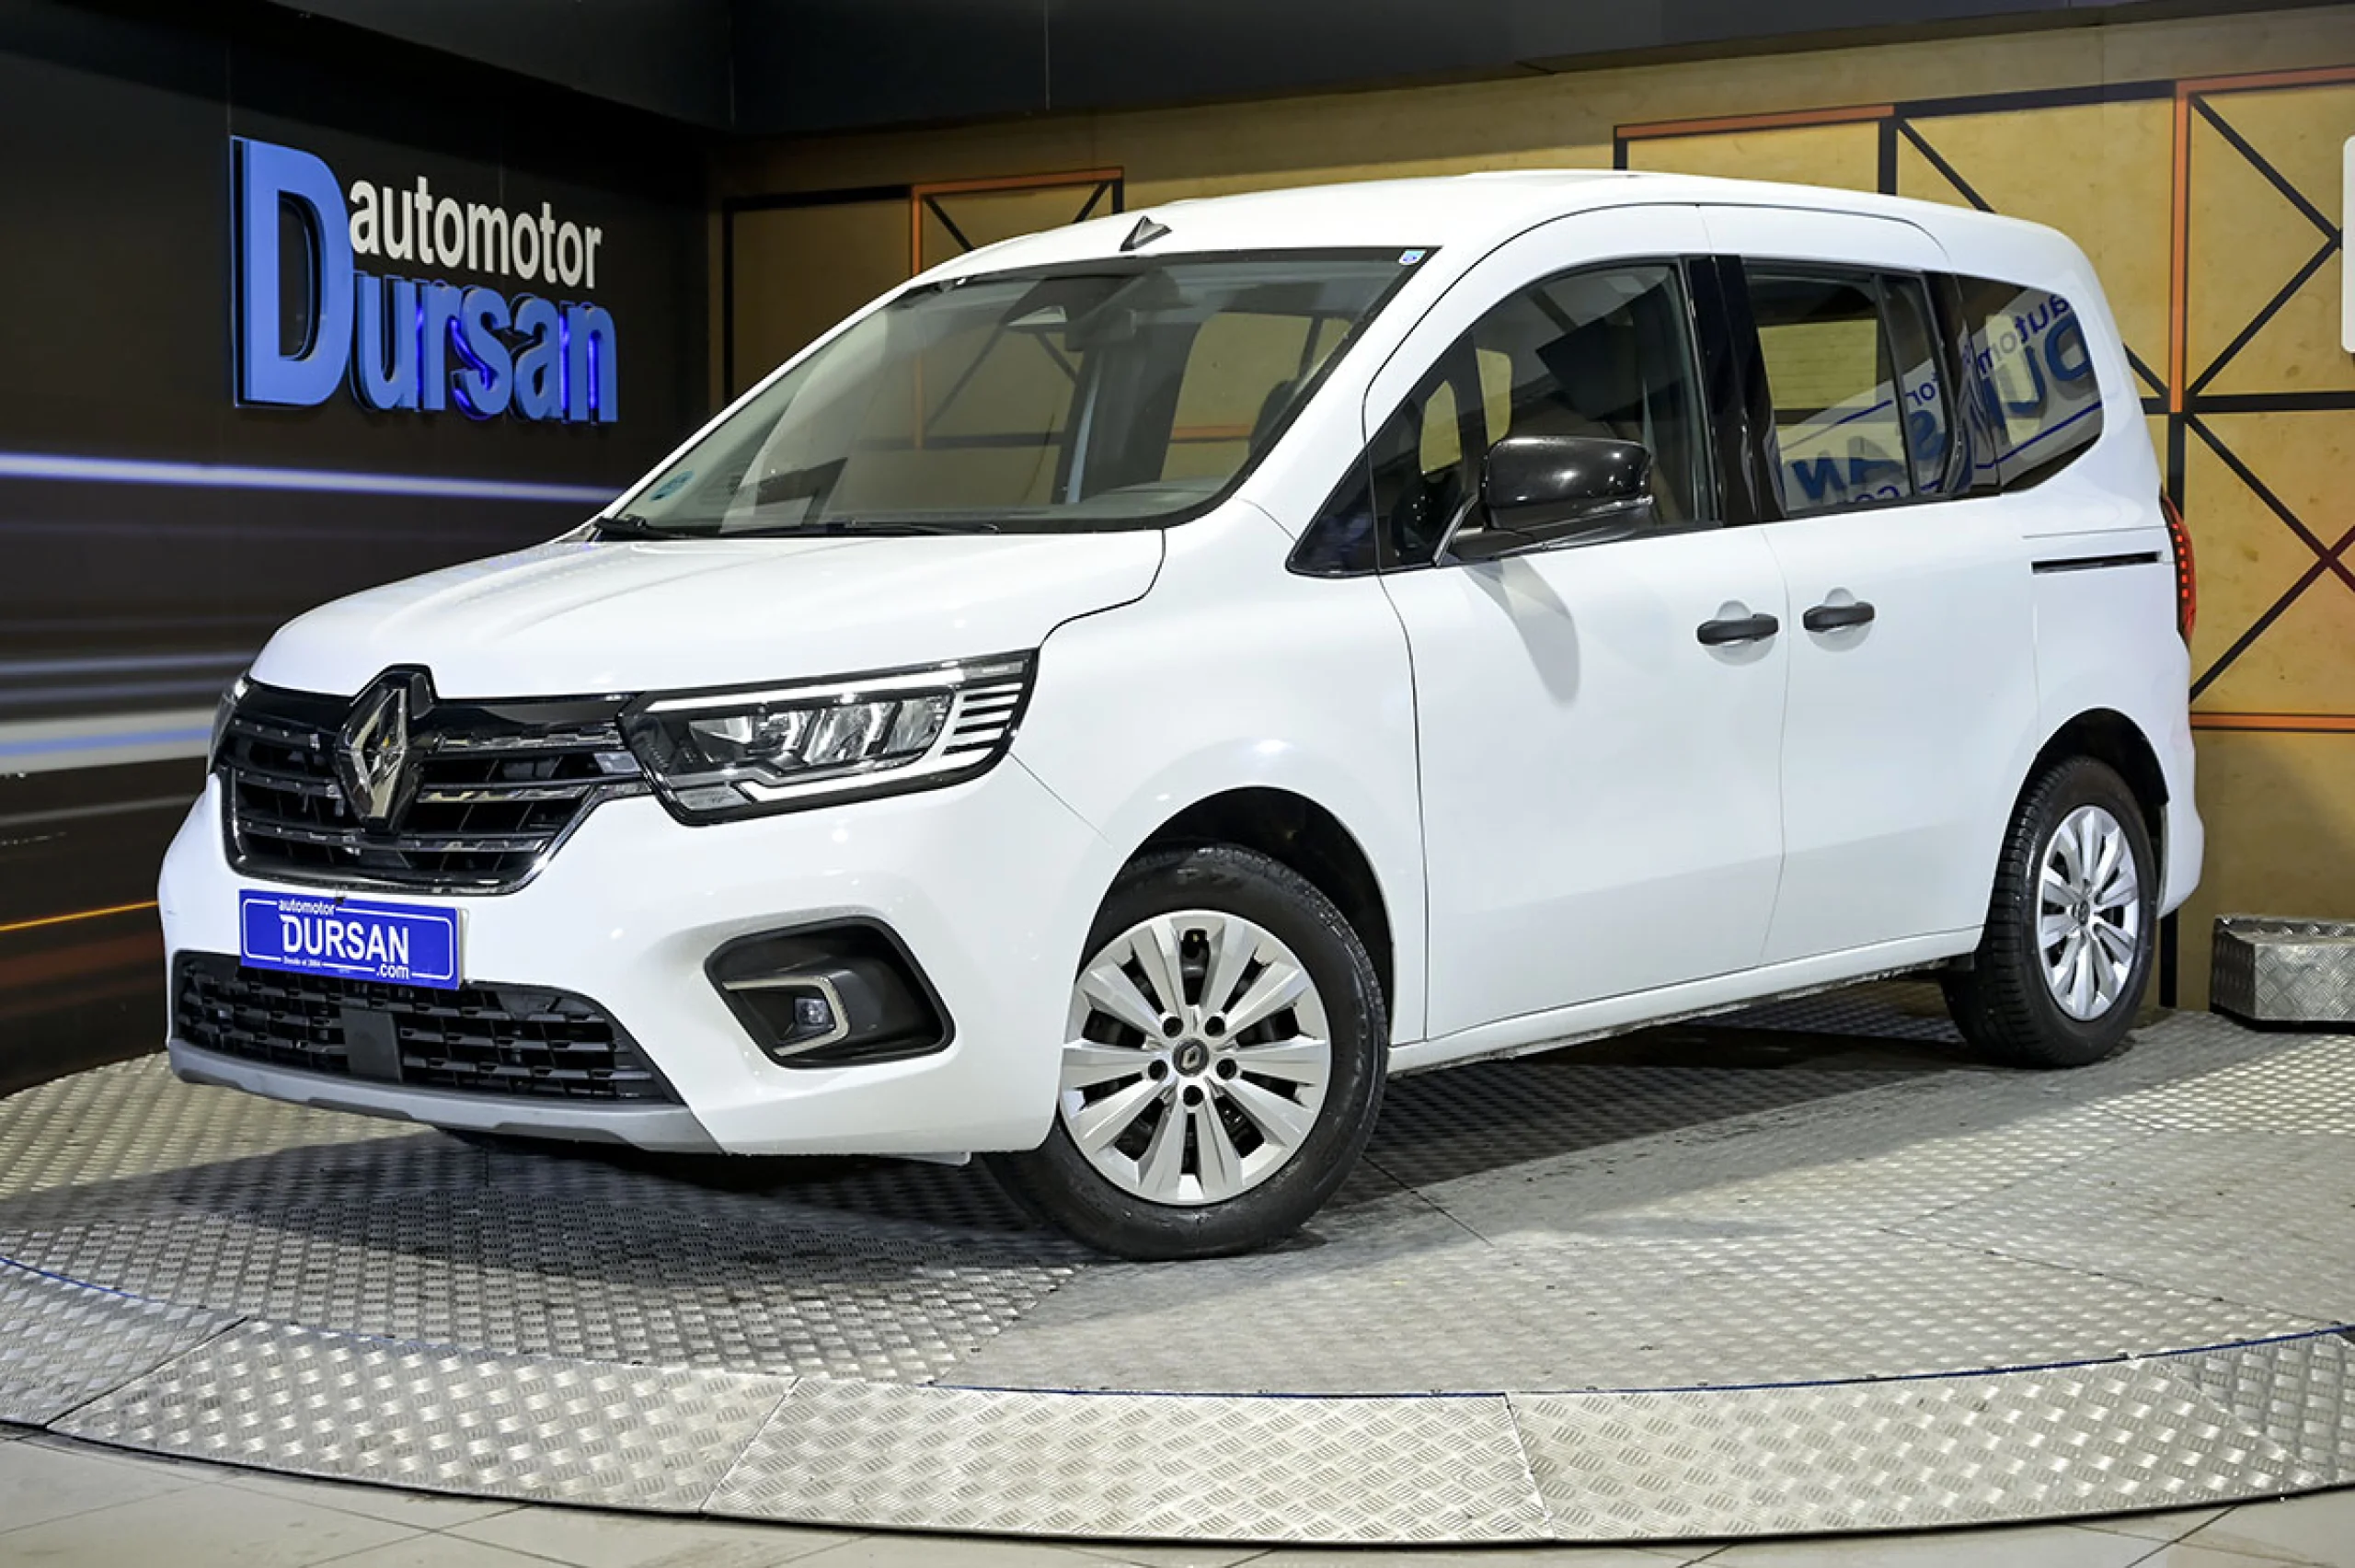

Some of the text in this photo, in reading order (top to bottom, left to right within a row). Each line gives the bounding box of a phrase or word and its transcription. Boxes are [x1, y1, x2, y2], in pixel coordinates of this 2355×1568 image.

[350, 177, 602, 288] automotor
[230, 135, 617, 423] Dursan
[279, 899, 335, 915] automotor
[280, 914, 409, 965] DURSAN
[376, 963, 410, 979] .com
